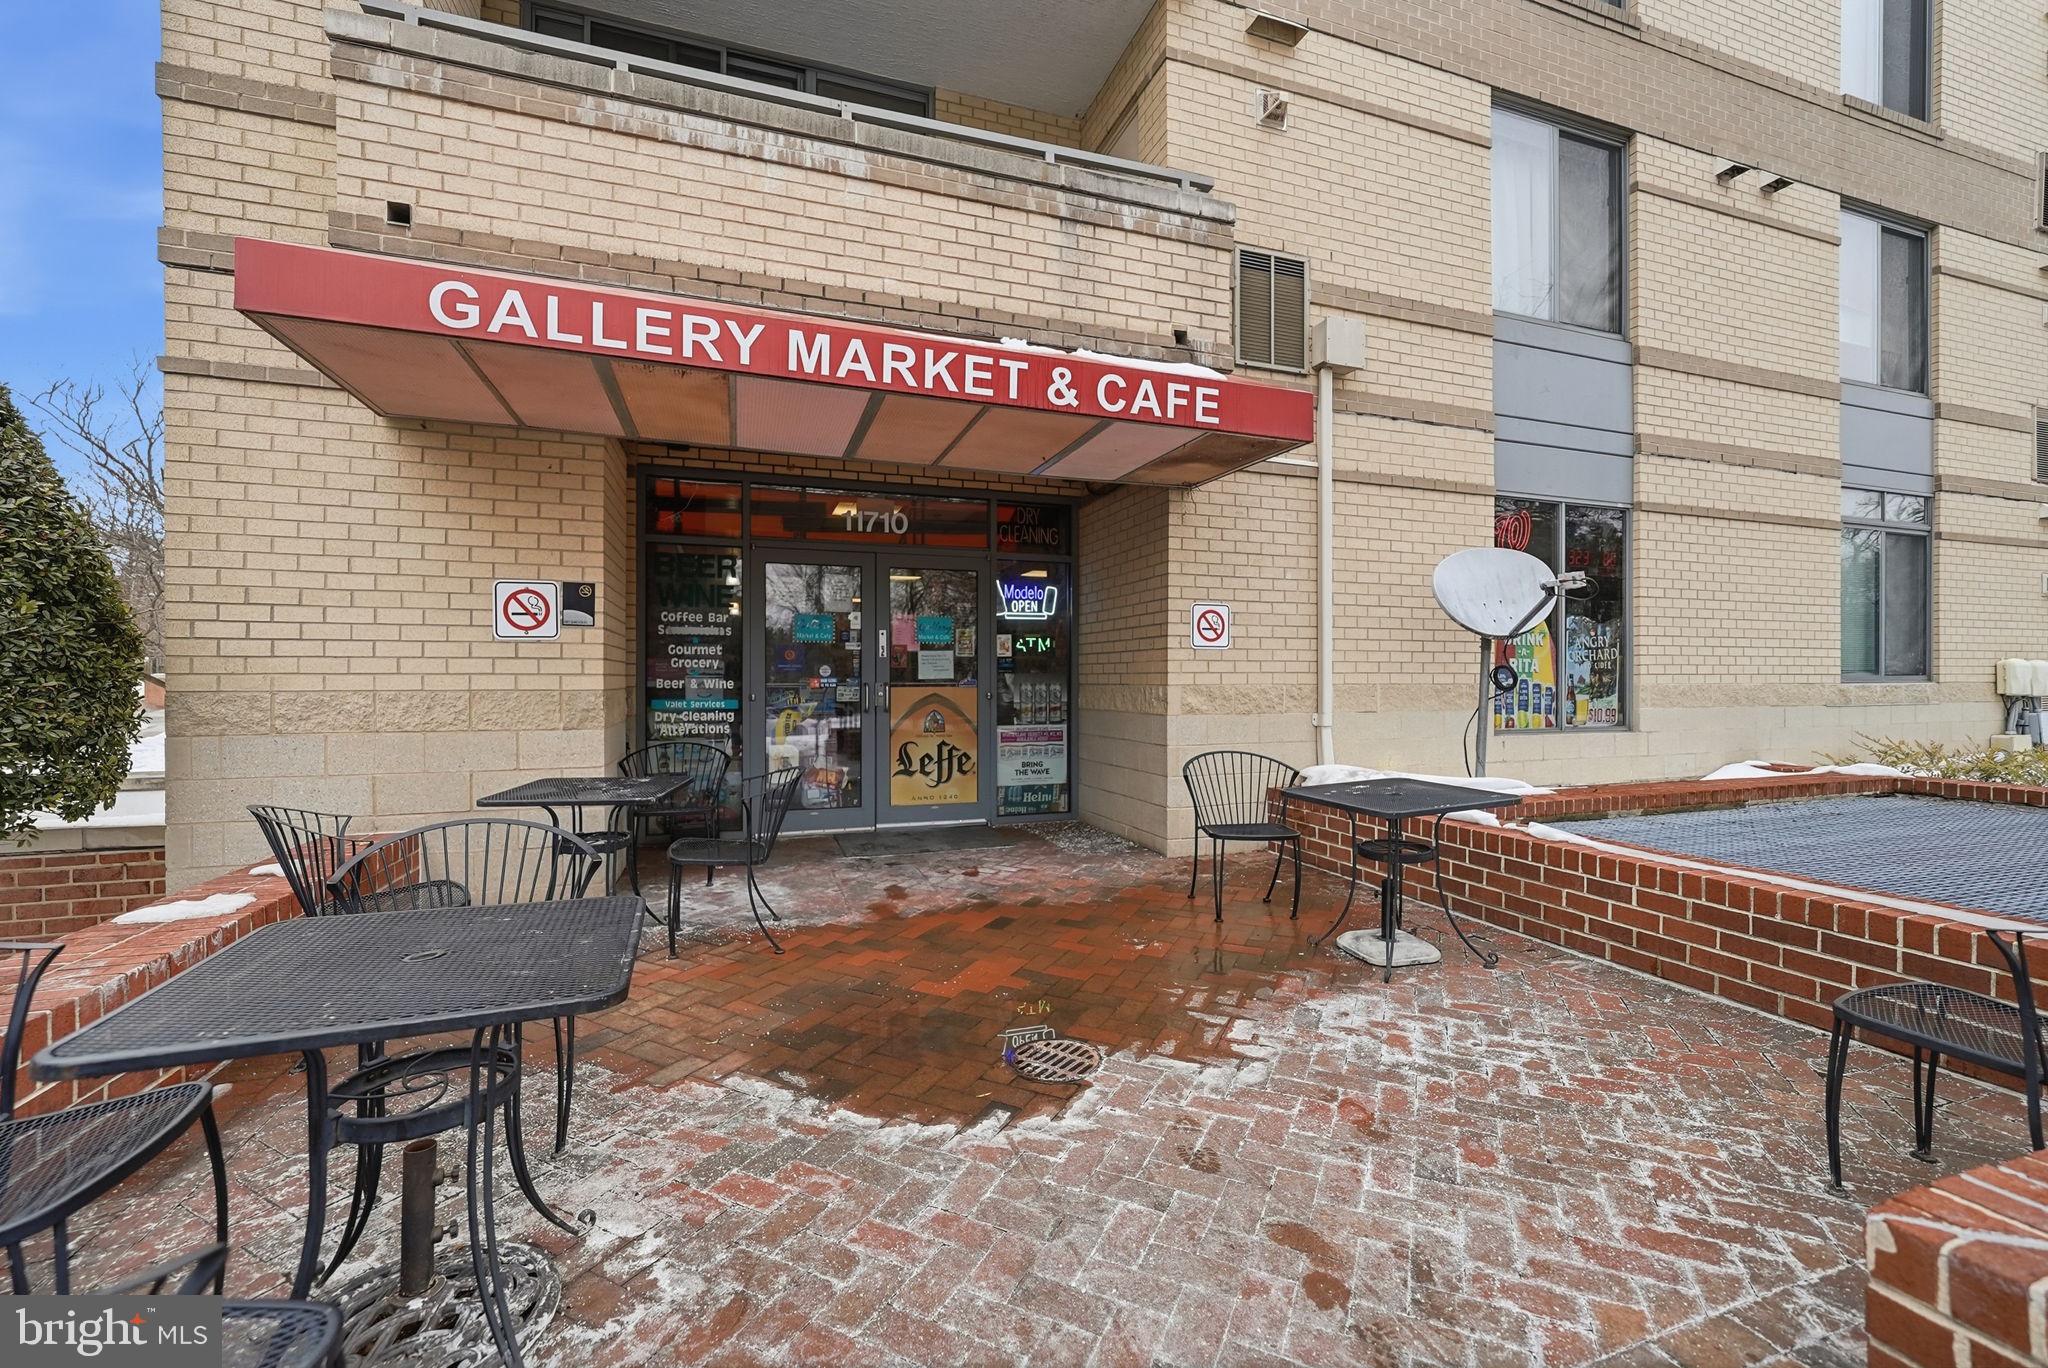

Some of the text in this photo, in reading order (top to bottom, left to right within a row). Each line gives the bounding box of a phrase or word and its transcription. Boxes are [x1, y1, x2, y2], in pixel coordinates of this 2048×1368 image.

[428, 280, 1220, 425] GALLERY MARKET & CAFE
[842, 510, 909, 535] 11710
[1017, 506, 1041, 525] DRY
[1000, 524, 1060, 546] CLEANING
[1004, 584, 1044, 600] Modelo
[1011, 600, 1039, 613] OPEN
[661, 611, 729, 623] Coffee Bar
[1575, 635, 1610, 648] ANGRY
[668, 644, 723, 655] Gourmet
[671, 657, 720, 669] Grocery
[1509, 657, 1539, 673] RITA
[656, 678, 735, 689] Beer & Wine
[690, 700, 726, 708] Services
[1588, 708, 1617, 723] $10.99
[659, 722, 731, 736] Alterations
[892, 739, 976, 788] Leffe
